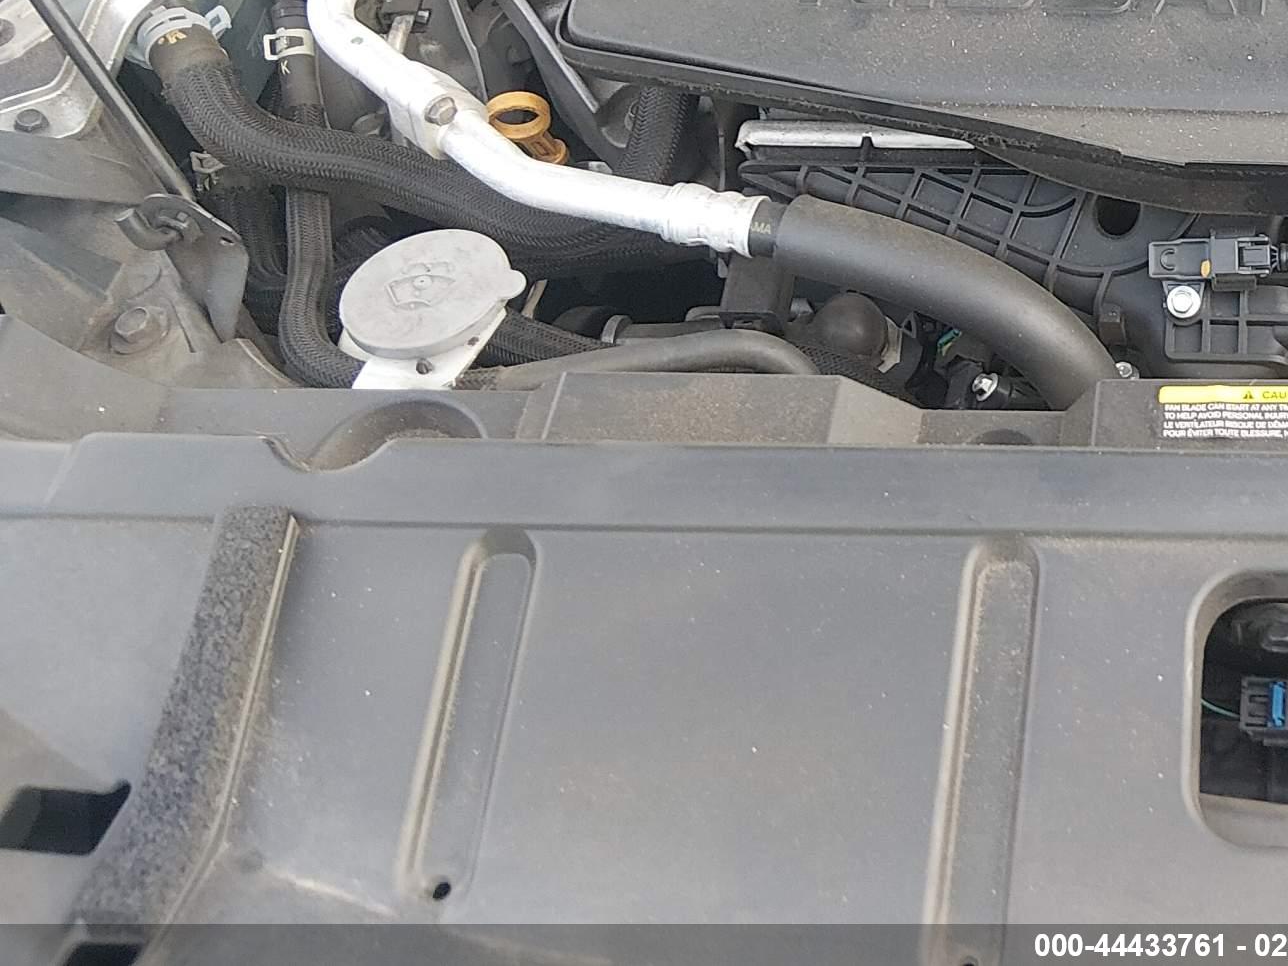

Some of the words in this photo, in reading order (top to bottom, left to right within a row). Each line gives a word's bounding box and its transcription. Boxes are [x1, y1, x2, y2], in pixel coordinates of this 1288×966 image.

[1165, 403, 1181, 412] FAN
[1181, 403, 1207, 412] BLADE
[1207, 403, 1225, 412] CAN
[1225, 403, 1250, 412] START
[1250, 403, 1260, 412] AT
[1260, 403, 1277, 412] ANY
[1164, 412, 1176, 420] TO
[1176, 412, 1198, 420] HELP
[1198, 412, 1222, 420] AVOID
[1222, 412, 1264, 420] PERSONAL
[1163, 420, 1174, 429] LE
[1225, 420, 1255, 429] RISQUE
[1255, 420, 1267, 429] DE
[1162, 429, 1187, 438] POUR
[1214, 429, 1239, 438] TOUTE
